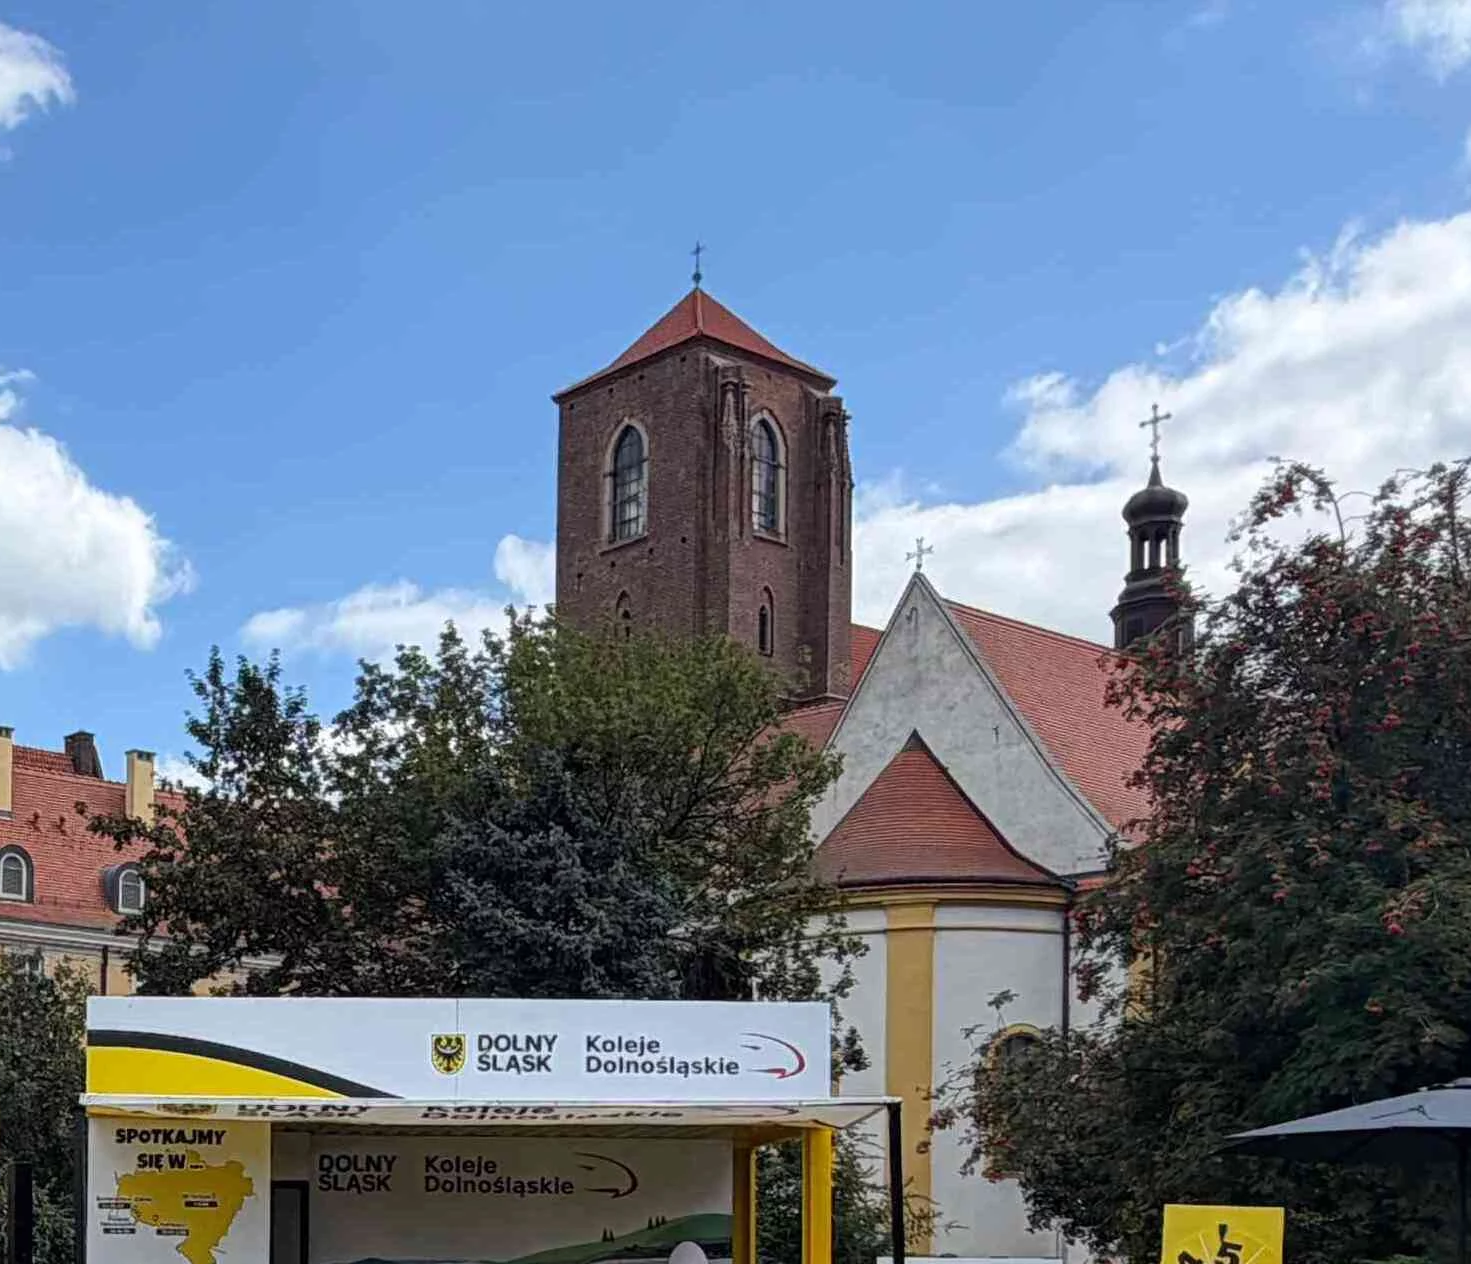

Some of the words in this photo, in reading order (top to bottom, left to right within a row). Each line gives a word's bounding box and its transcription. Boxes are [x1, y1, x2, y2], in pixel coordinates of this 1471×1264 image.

[477, 1034, 558, 1052] DOLNY
[585, 1035, 661, 1056] Koleje
[477, 1052, 553, 1075] ŚLĄSK
[585, 1055, 740, 1078] Dolnośląskie
[116, 1128, 227, 1145] SPOTKAJMY
[137, 1153, 164, 1173] SIĘ
[169, 1154, 187, 1169] W
[317, 1154, 397, 1174] DOLNY
[424, 1155, 498, 1176] Koleje
[317, 1172, 392, 1194] ŚLĄSK
[424, 1175, 574, 1197] Dolnośląskie
